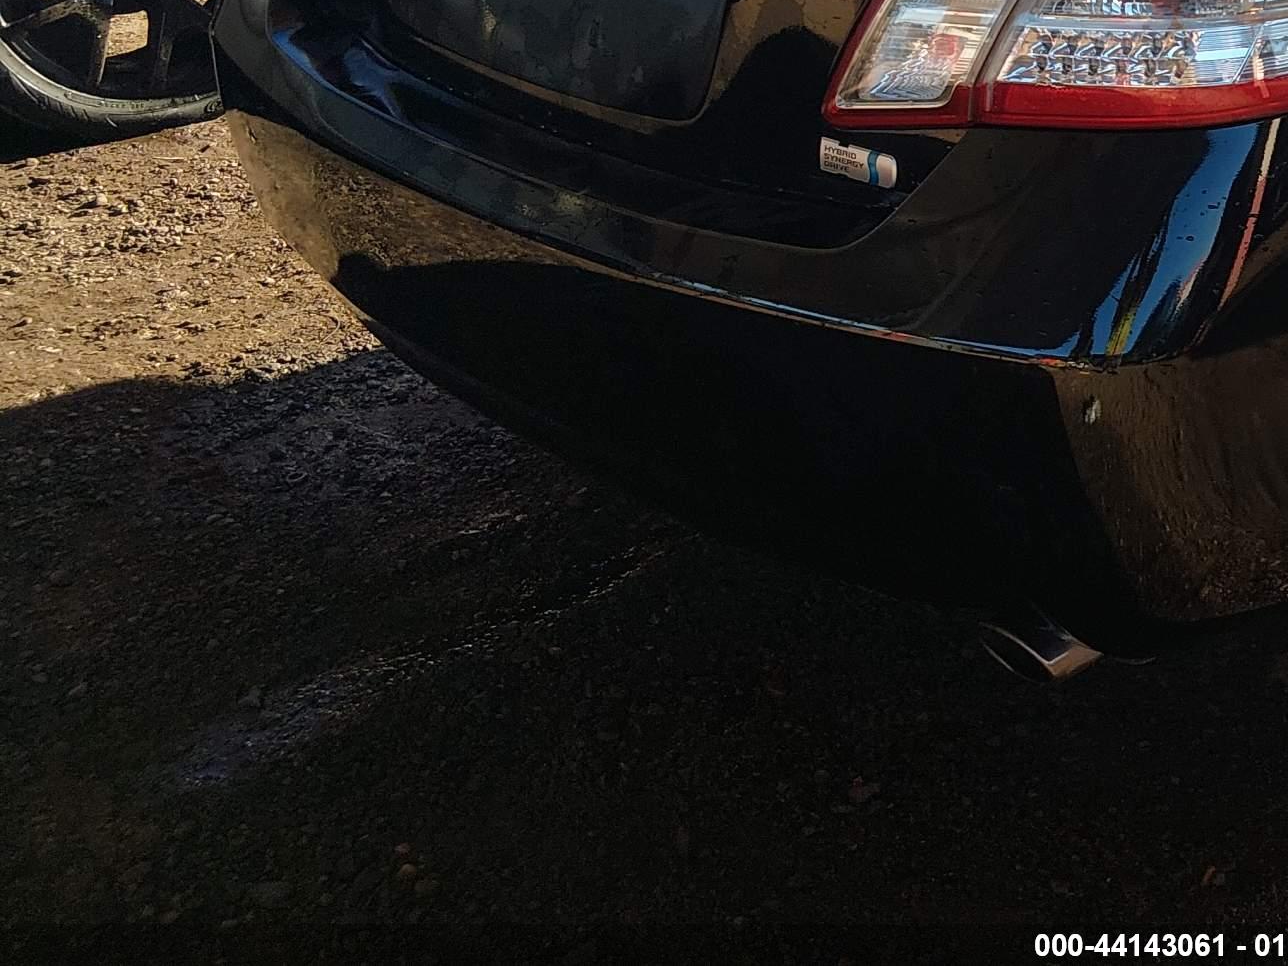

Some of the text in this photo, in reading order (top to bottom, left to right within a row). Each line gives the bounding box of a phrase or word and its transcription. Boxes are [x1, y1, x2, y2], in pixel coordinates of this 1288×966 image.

[824, 146, 857, 160] HYBRID
[824, 153, 865, 169] SYNERGY
[824, 160, 850, 172] DRIVE
